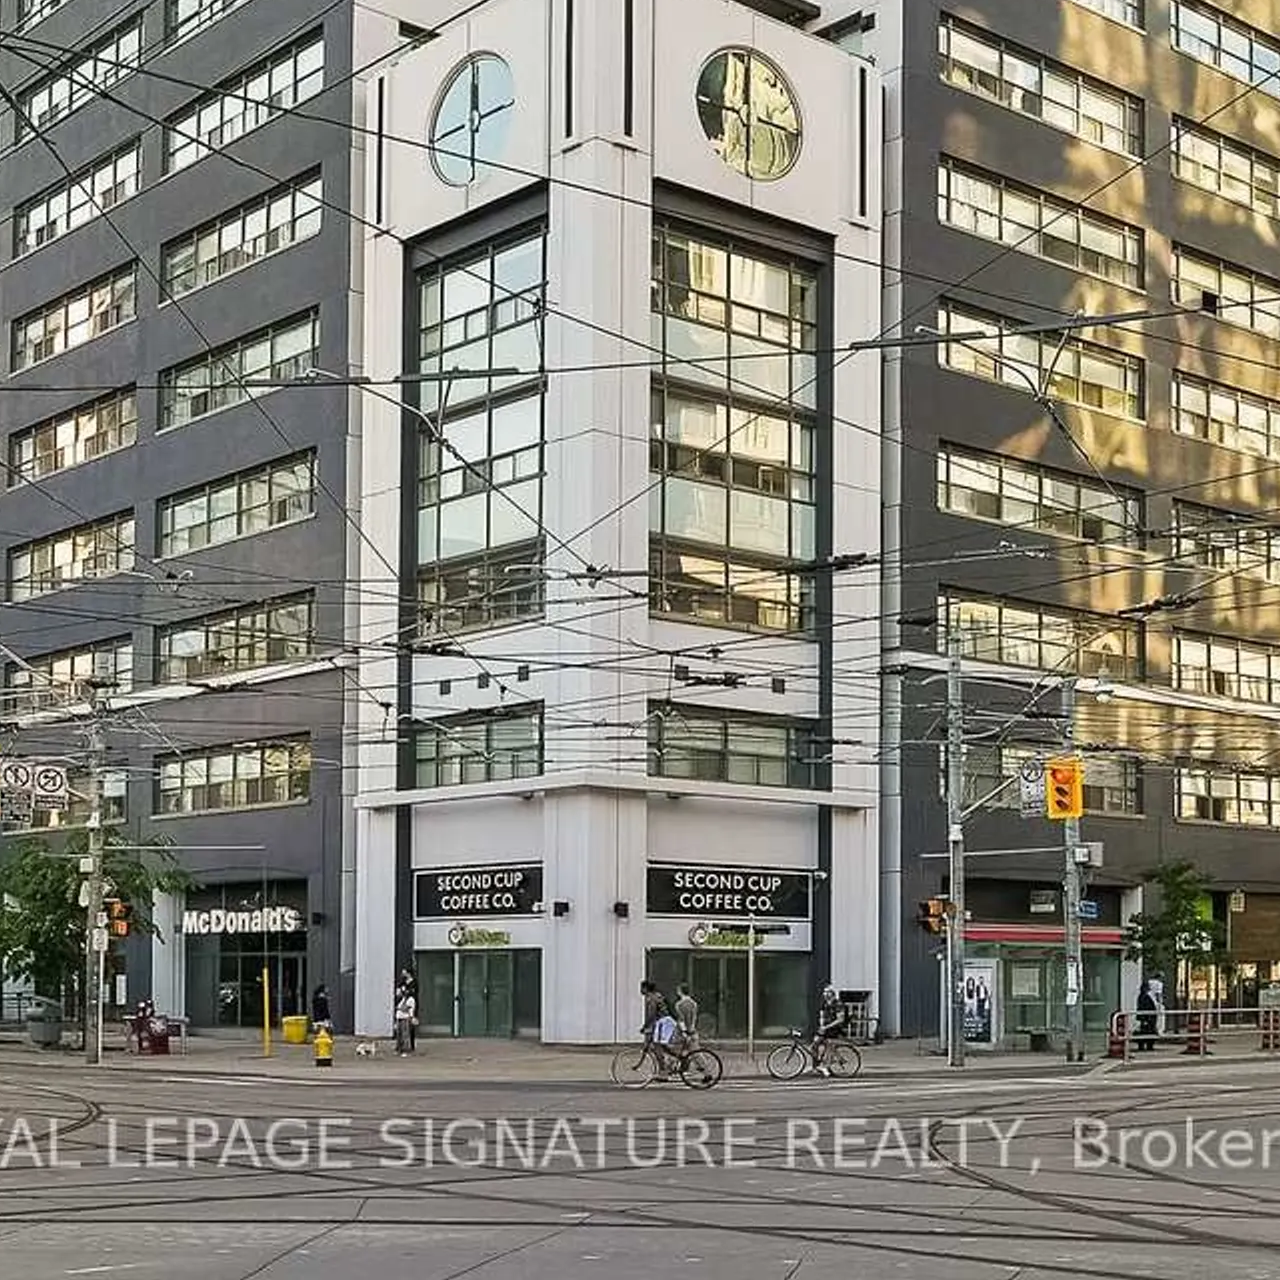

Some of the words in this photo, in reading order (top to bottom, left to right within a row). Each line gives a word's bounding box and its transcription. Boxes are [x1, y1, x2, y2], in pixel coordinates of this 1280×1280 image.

[437, 874, 492, 891] SECOND
[494, 871, 523, 888] CUP
[674, 872, 745, 889] SECOND
[747, 877, 782, 891] CUP
[441, 893, 489, 910] COFFEE
[492, 893, 516, 908] CO.
[679, 893, 742, 909] COFFEE
[745, 895, 774, 911] CO.
[182, 906, 298, 933] McDonald's
